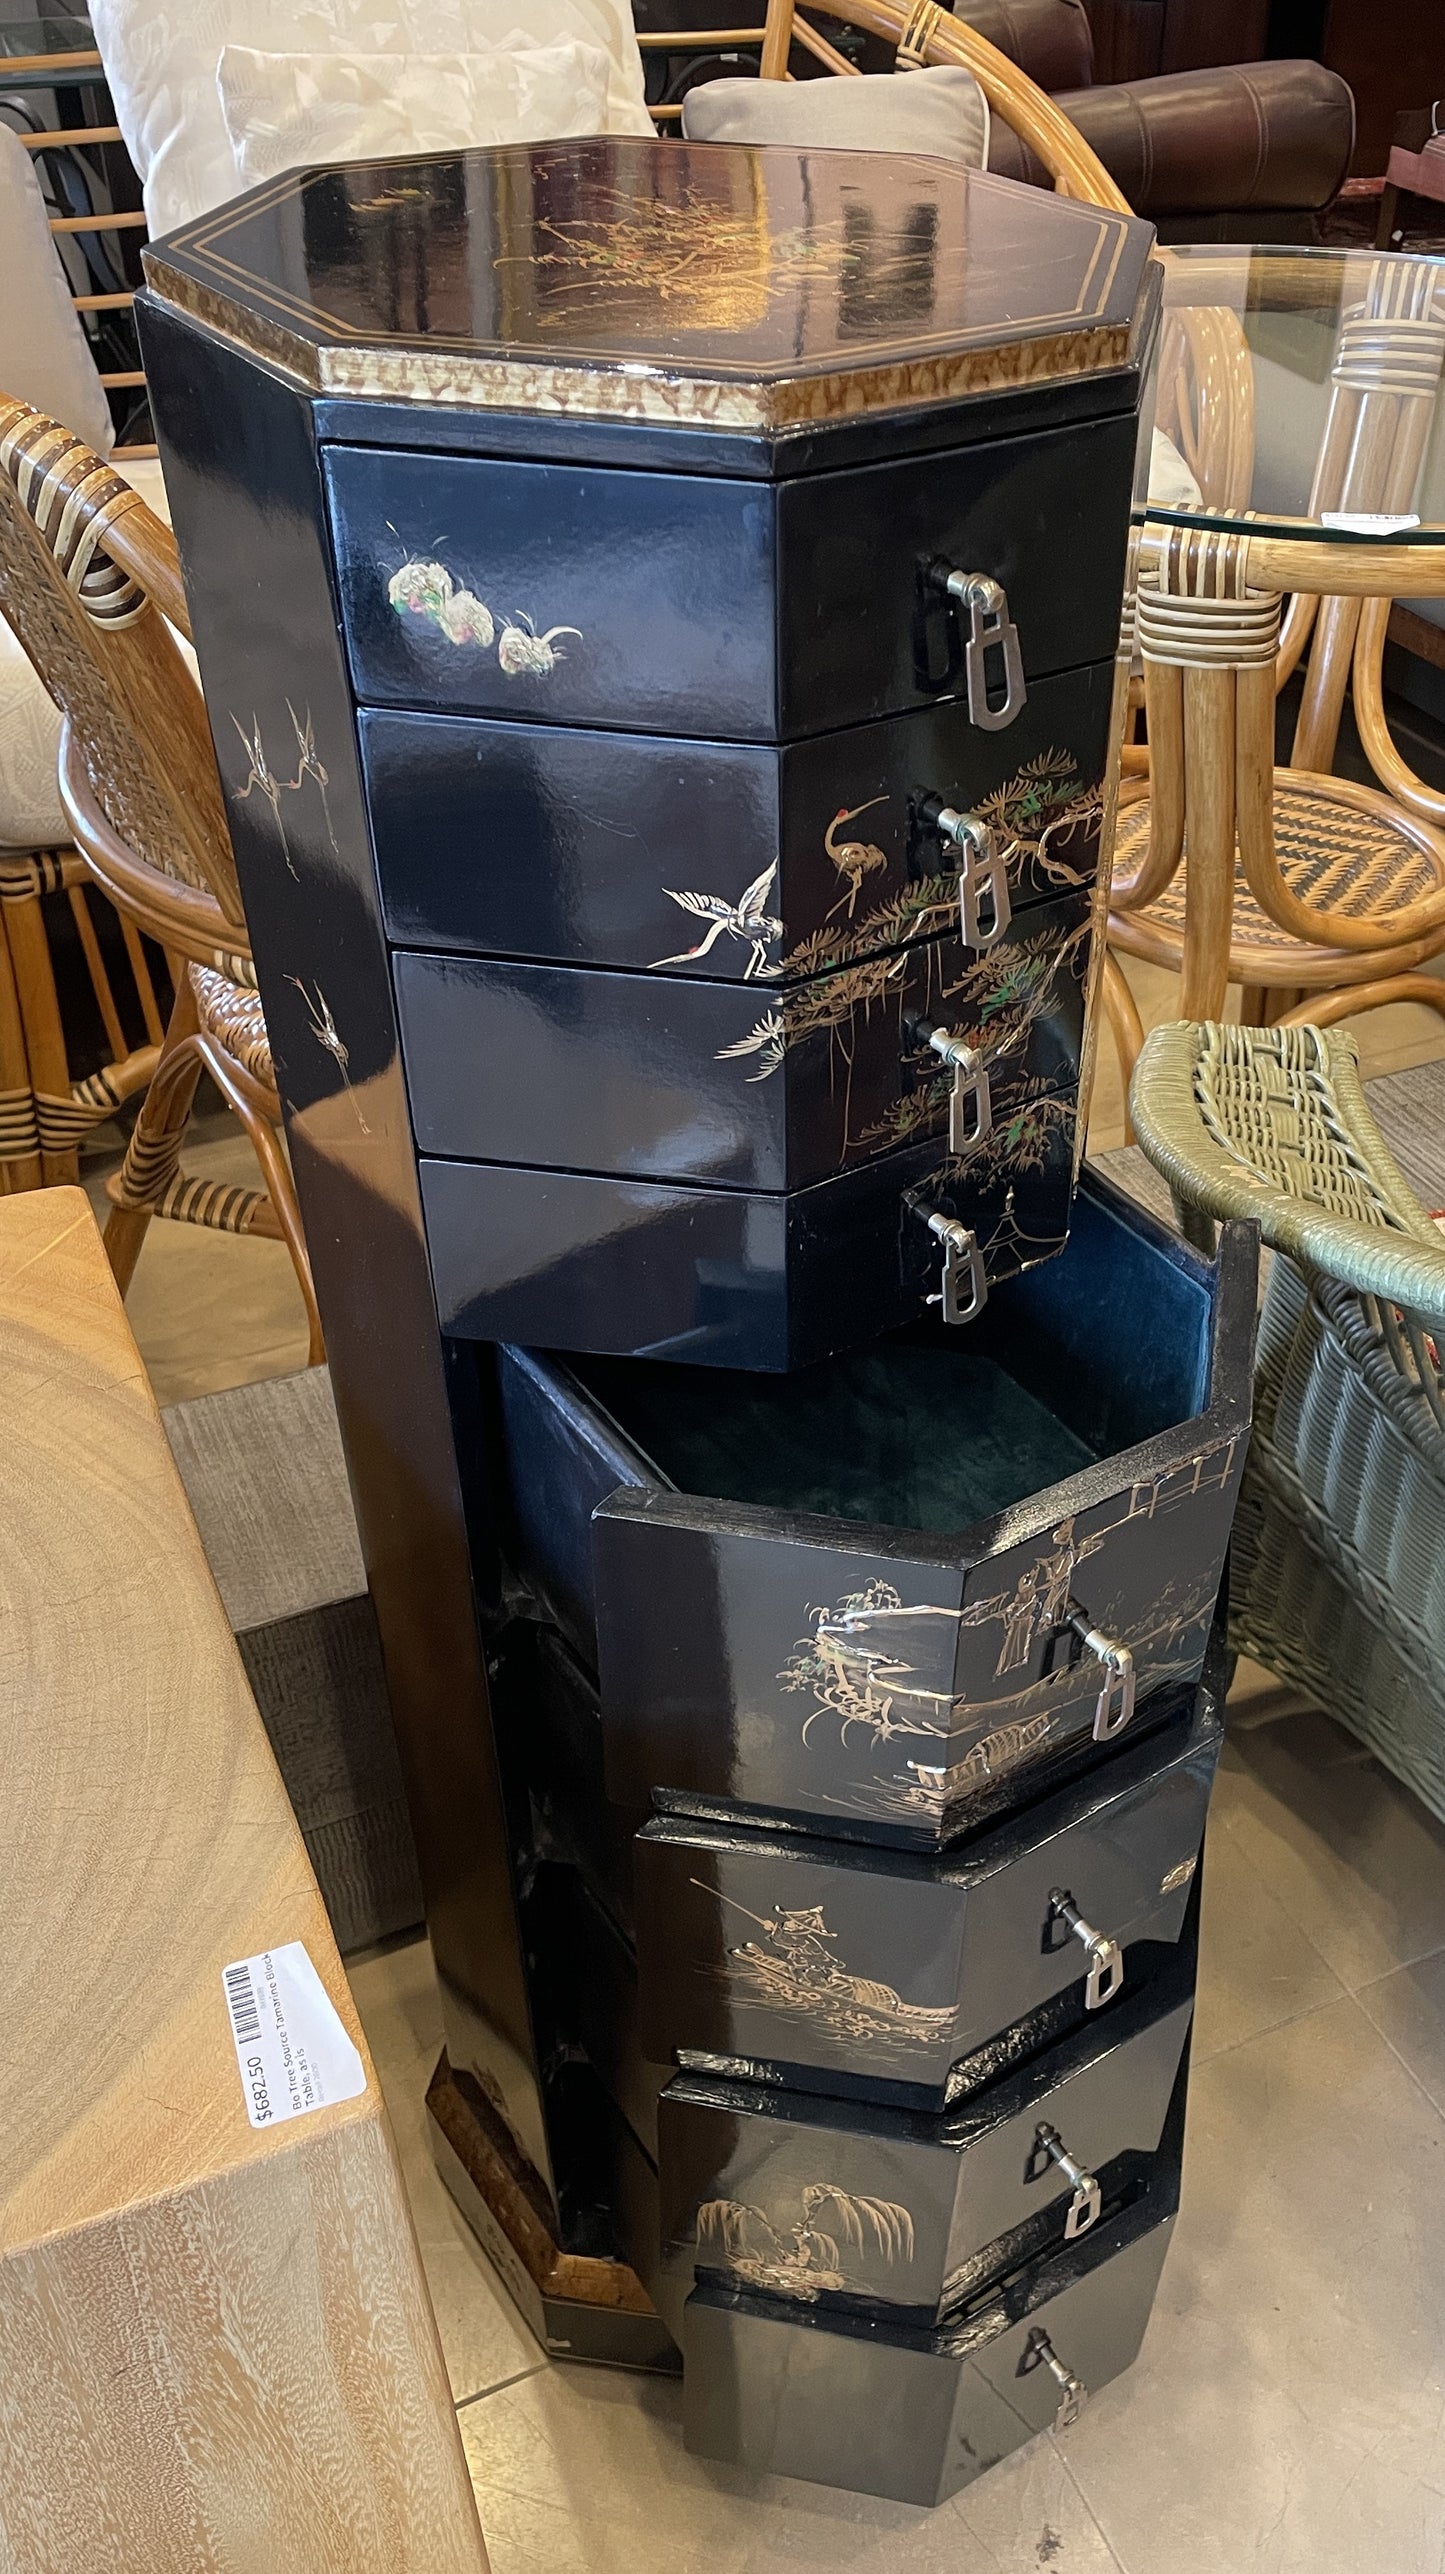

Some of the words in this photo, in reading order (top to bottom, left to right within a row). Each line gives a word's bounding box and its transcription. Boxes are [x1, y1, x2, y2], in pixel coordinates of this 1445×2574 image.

[261, 1954, 275, 1981] Block
[280, 2031, 293, 2067] Source
[294, 2048, 305, 2059] is
[299, 2059, 308, 2071] as
[247, 2057, 274, 2121] $682.50
[287, 2069, 298, 2093] Tree
[293, 2095, 302, 2110] Bo
